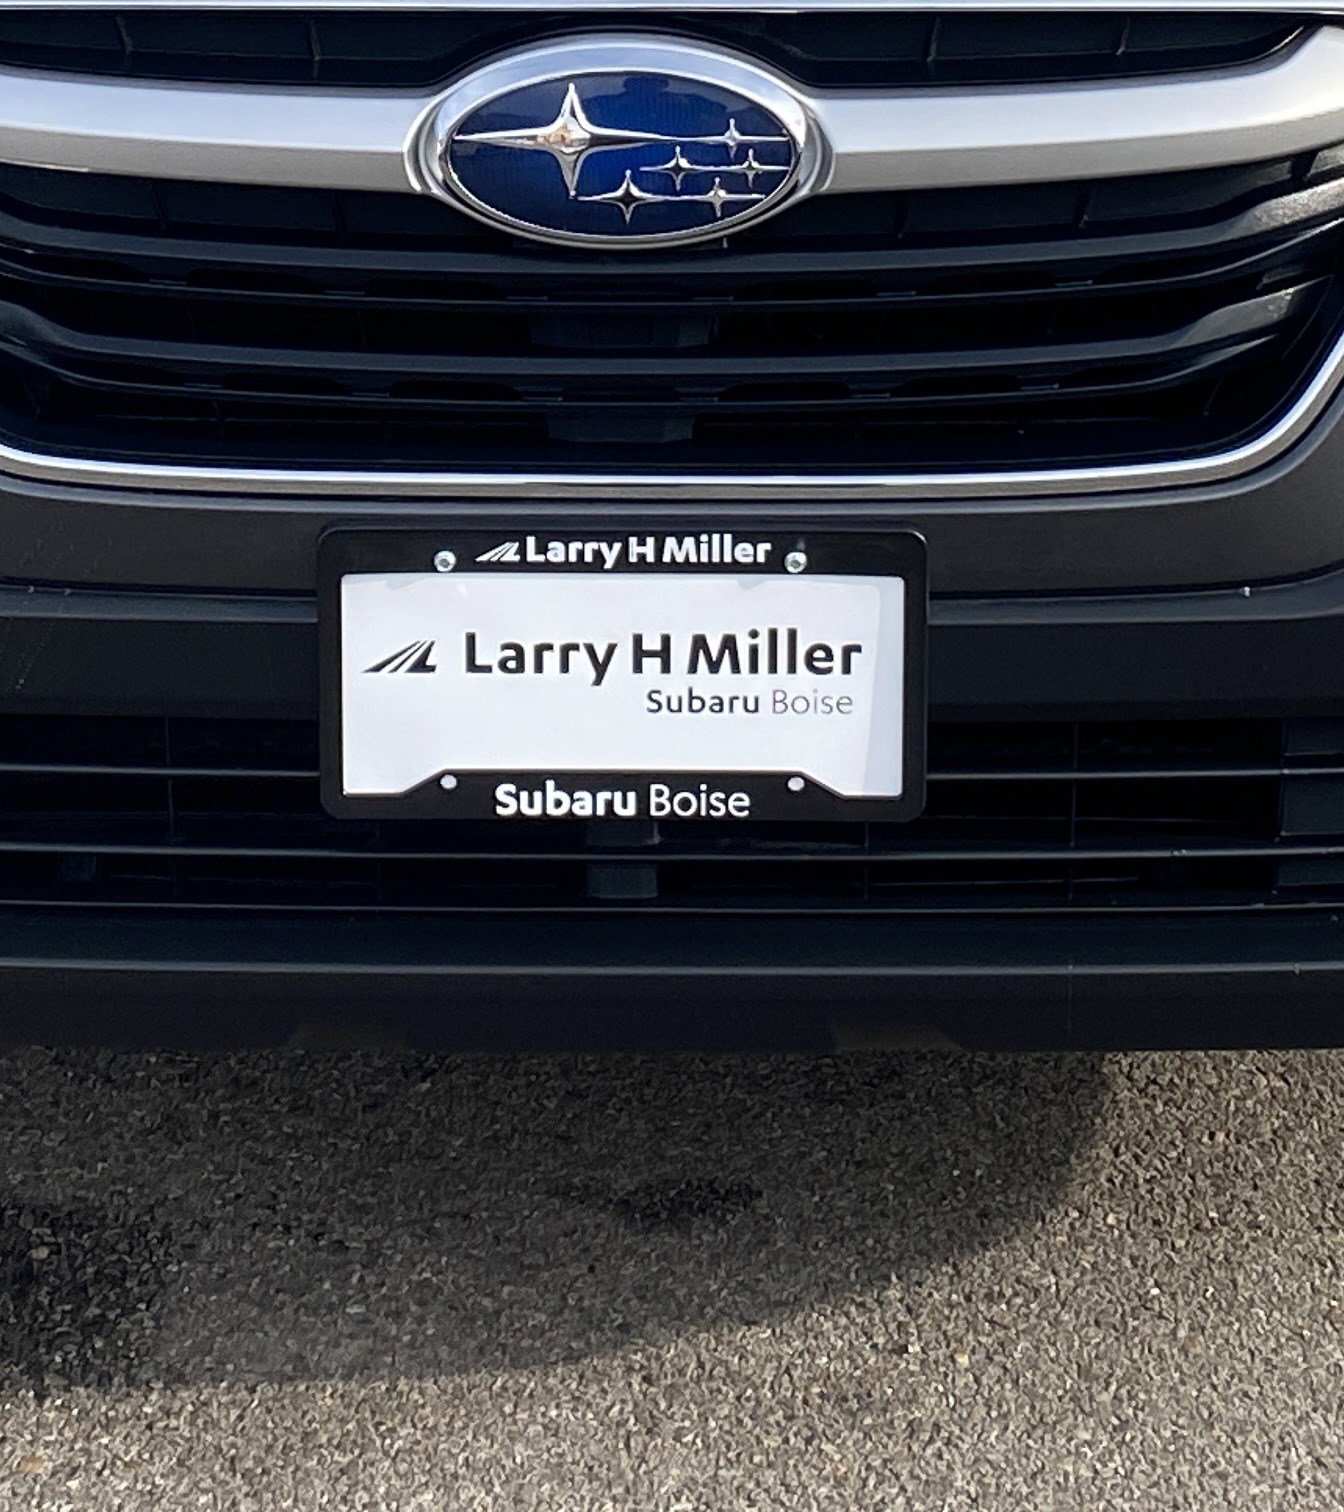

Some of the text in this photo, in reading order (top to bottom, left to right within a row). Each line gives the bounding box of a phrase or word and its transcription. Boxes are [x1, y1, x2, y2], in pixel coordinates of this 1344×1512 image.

[525, 533, 772, 570] Larry H Miller
[464, 627, 863, 687] Larry H Miller
[646, 687, 854, 715] Subaru Boise
[494, 779, 751, 818] Subaru Boise
